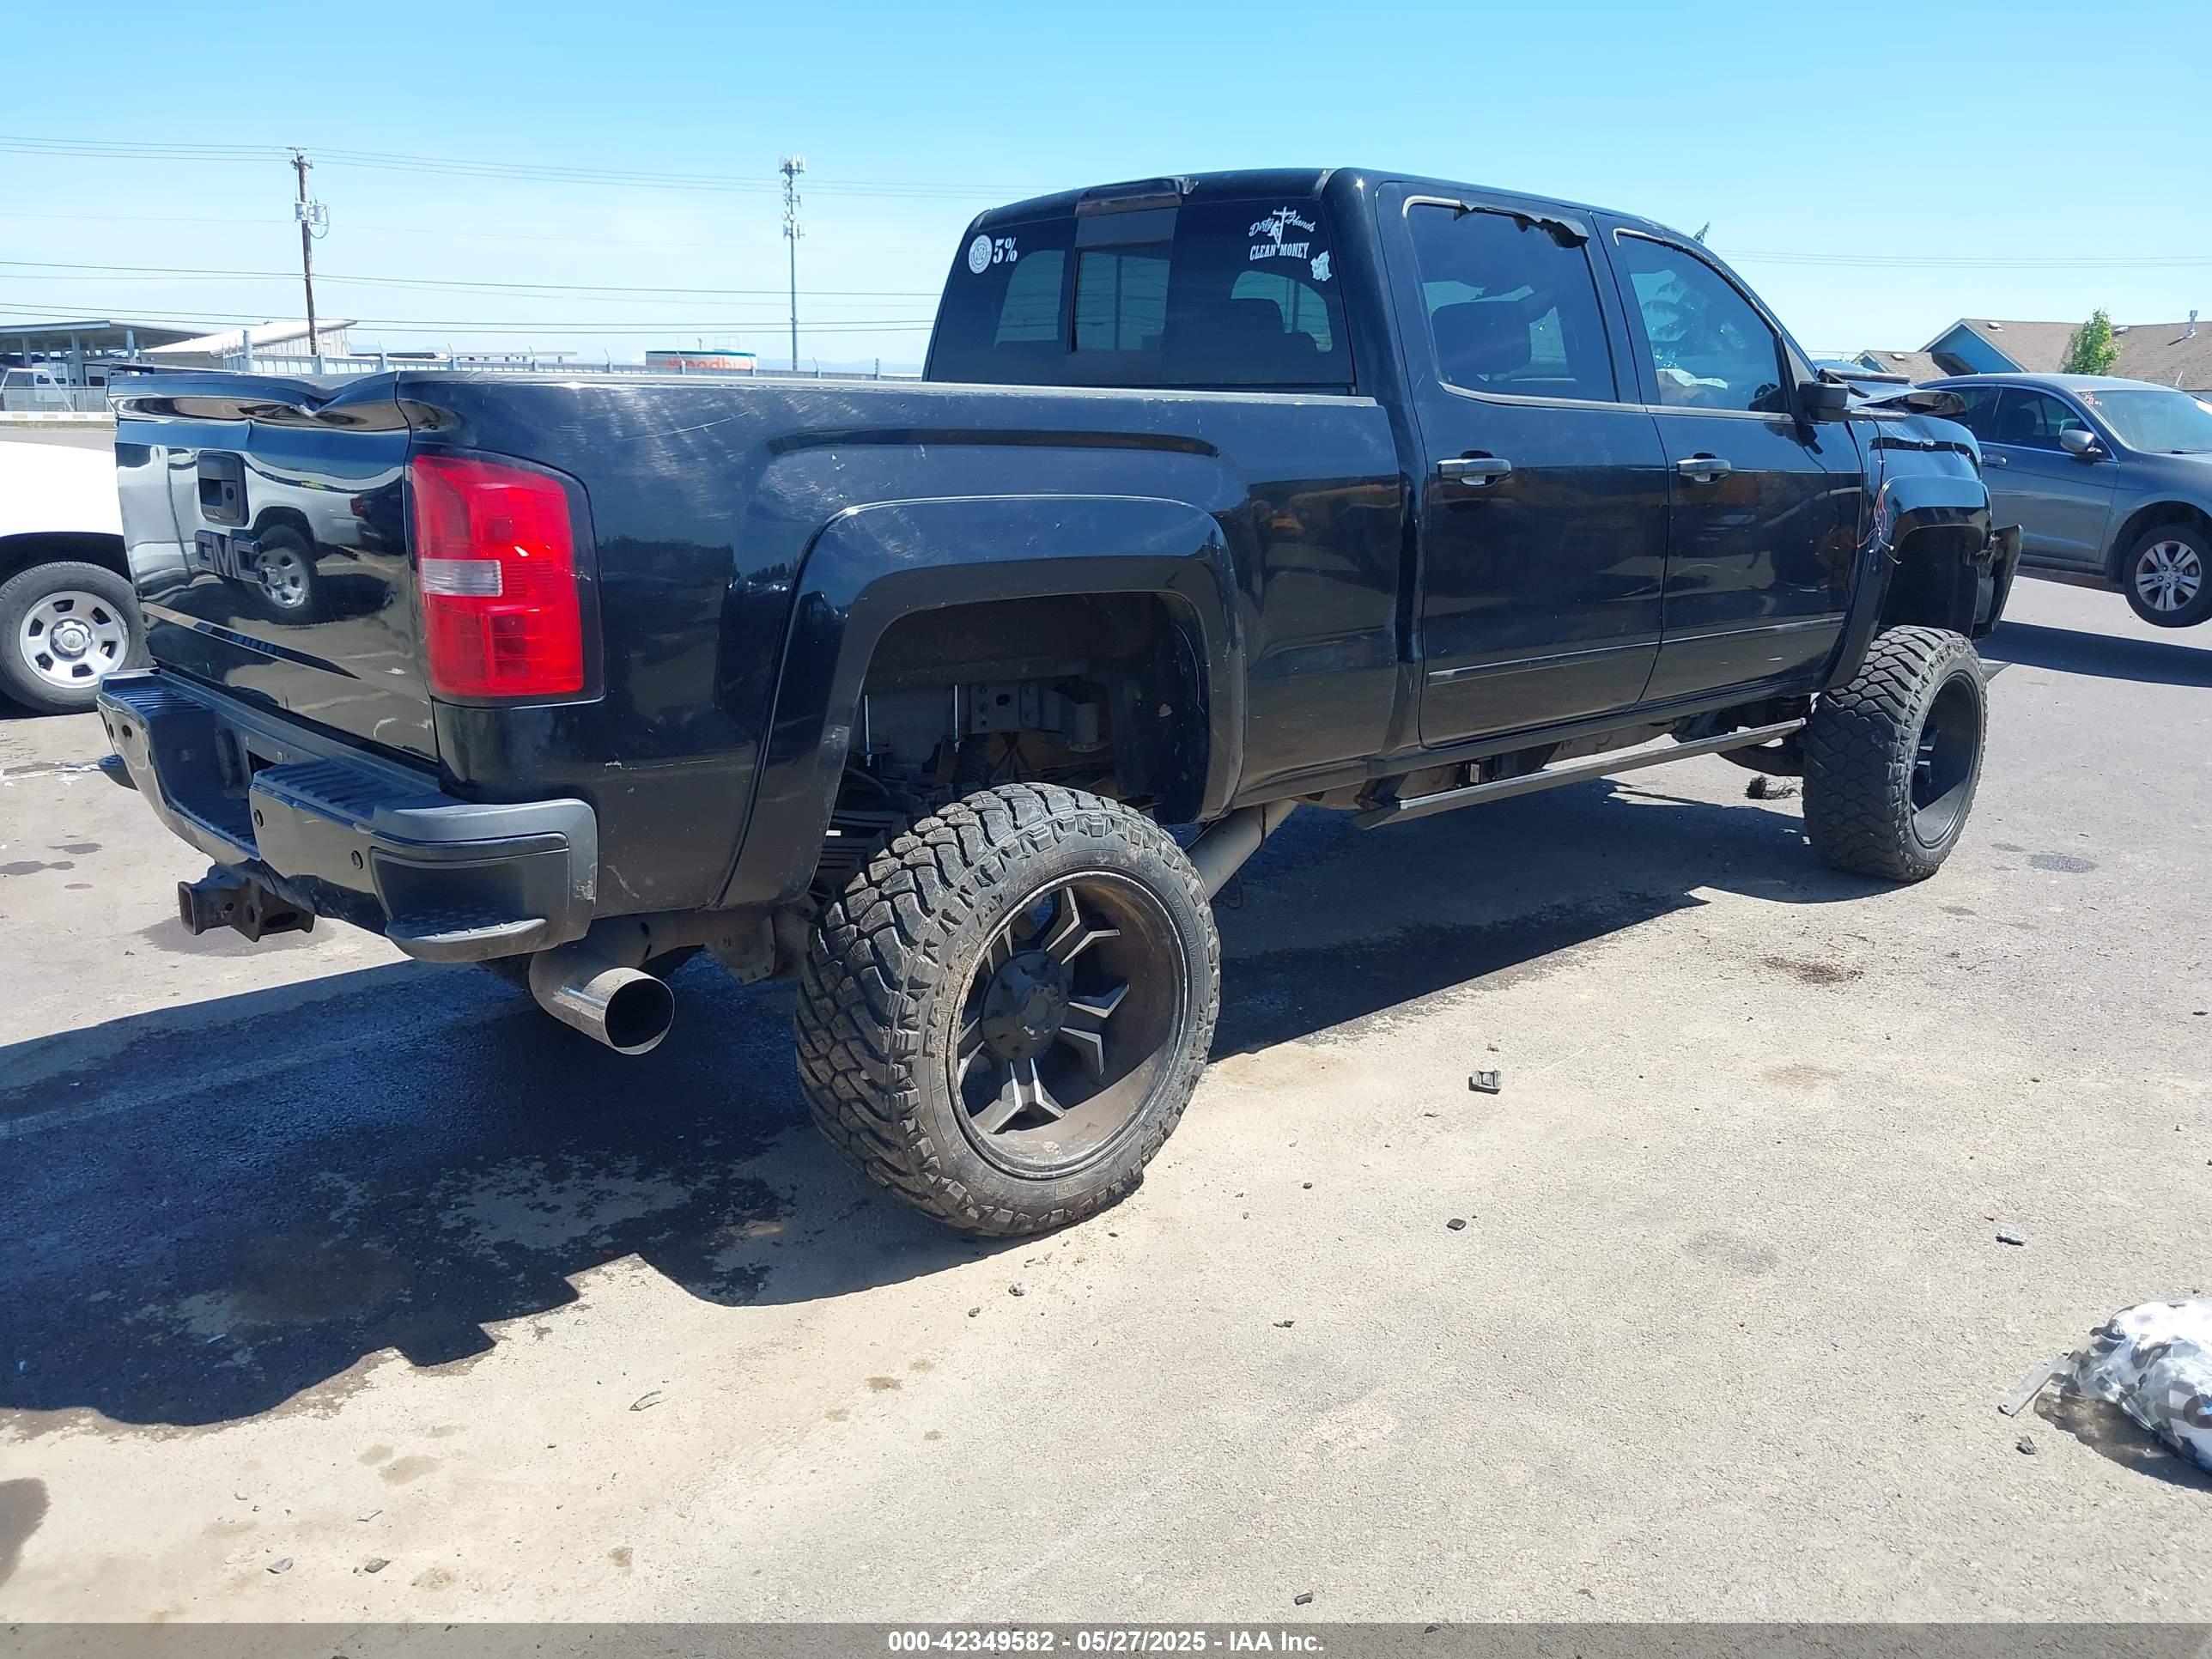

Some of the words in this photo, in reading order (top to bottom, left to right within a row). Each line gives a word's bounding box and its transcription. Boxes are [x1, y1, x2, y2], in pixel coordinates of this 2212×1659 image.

[1249, 216, 1274, 237] Dirty
[1285, 214, 1316, 233] Hands
[993, 237, 1018, 264] 5%
[1249, 244, 1277, 261] CLEAN
[1279, 242, 1310, 259] MONEY
[194, 529, 269, 585] GMC
